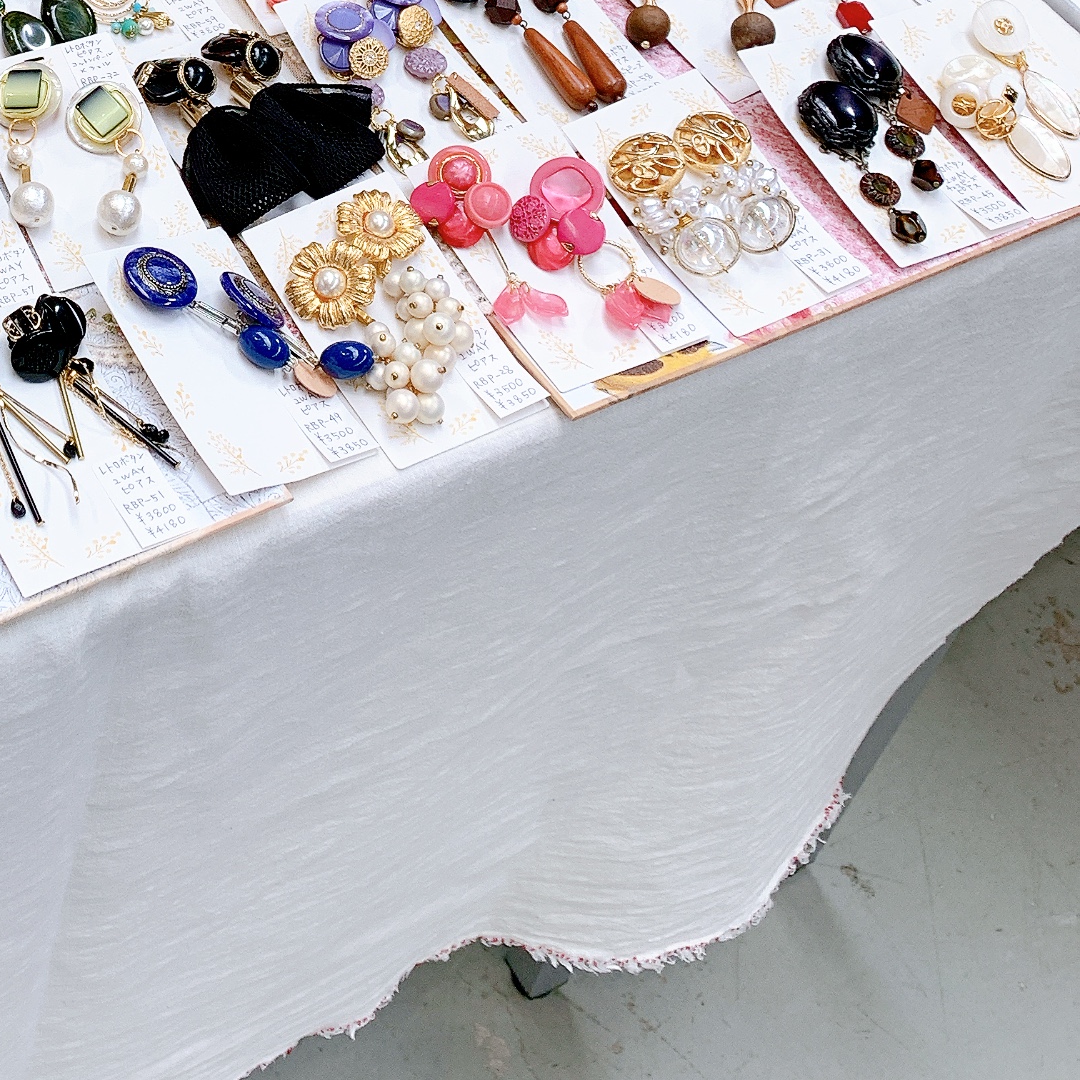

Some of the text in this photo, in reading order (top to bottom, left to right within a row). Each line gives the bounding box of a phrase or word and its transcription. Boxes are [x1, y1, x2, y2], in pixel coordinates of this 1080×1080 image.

[468, 354, 498, 372] ピアス
[300, 400, 330, 416] ピアス
[98, 453, 144, 476] レトロボタン
[113, 465, 146, 485] 2WAY
[121, 476, 155, 495] ピアス
[123, 491, 165, 515] RBP-51
[136, 504, 176, 526] ¥3800
[145, 515, 186, 539] ¥4180
